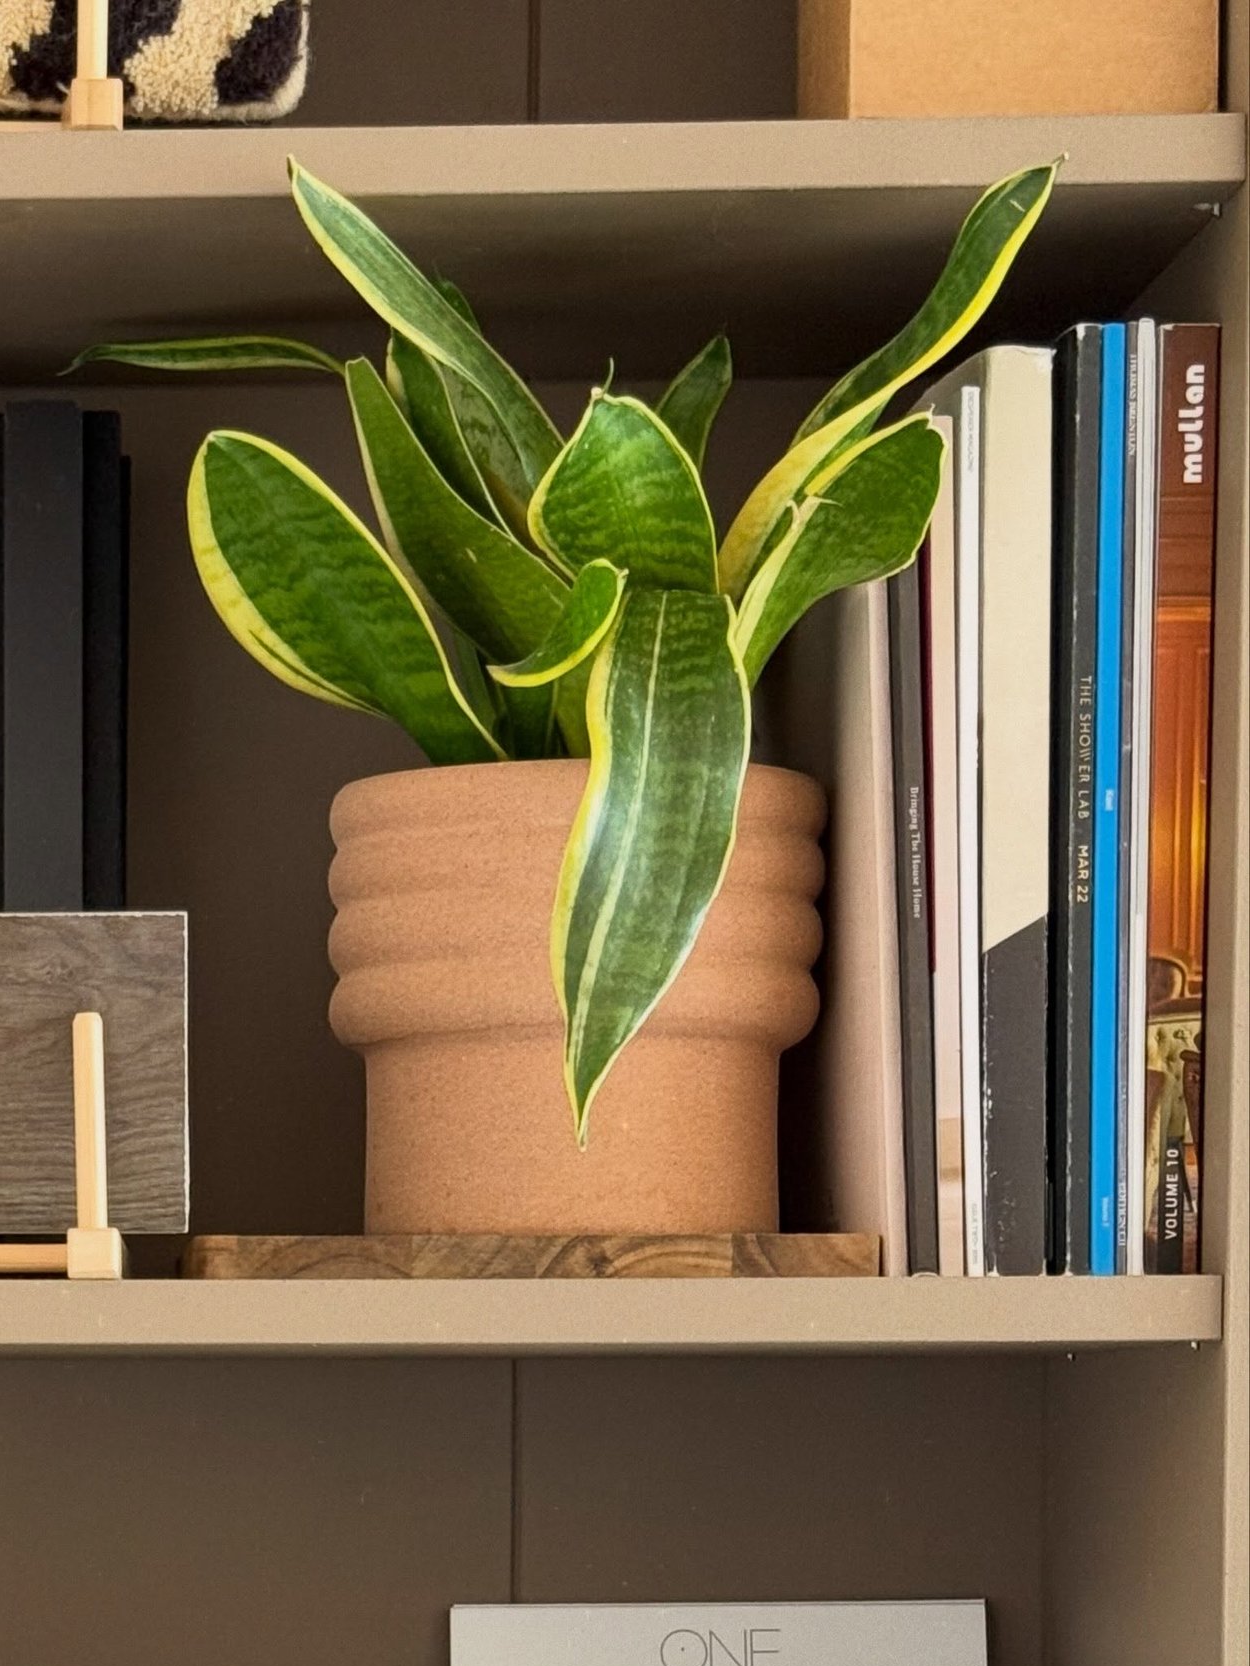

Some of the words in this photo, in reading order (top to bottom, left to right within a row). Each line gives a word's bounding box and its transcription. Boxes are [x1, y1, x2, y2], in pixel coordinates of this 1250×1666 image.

[1178, 364, 1206, 484] mullan
[1078, 675, 1092, 704] THE
[1077, 711, 1092, 787] SHOWER
[909, 786, 920, 830] Bringing
[1077, 790, 1090, 820] LAB
[910, 832, 921, 852] The
[911, 854, 922, 886] House
[1077, 845, 1090, 880] MAR
[912, 888, 923, 919] Home
[1076, 884, 1088, 904] 22
[1166, 1147, 1180, 1167] 10
[1164, 1169, 1180, 1241] VOLUME
